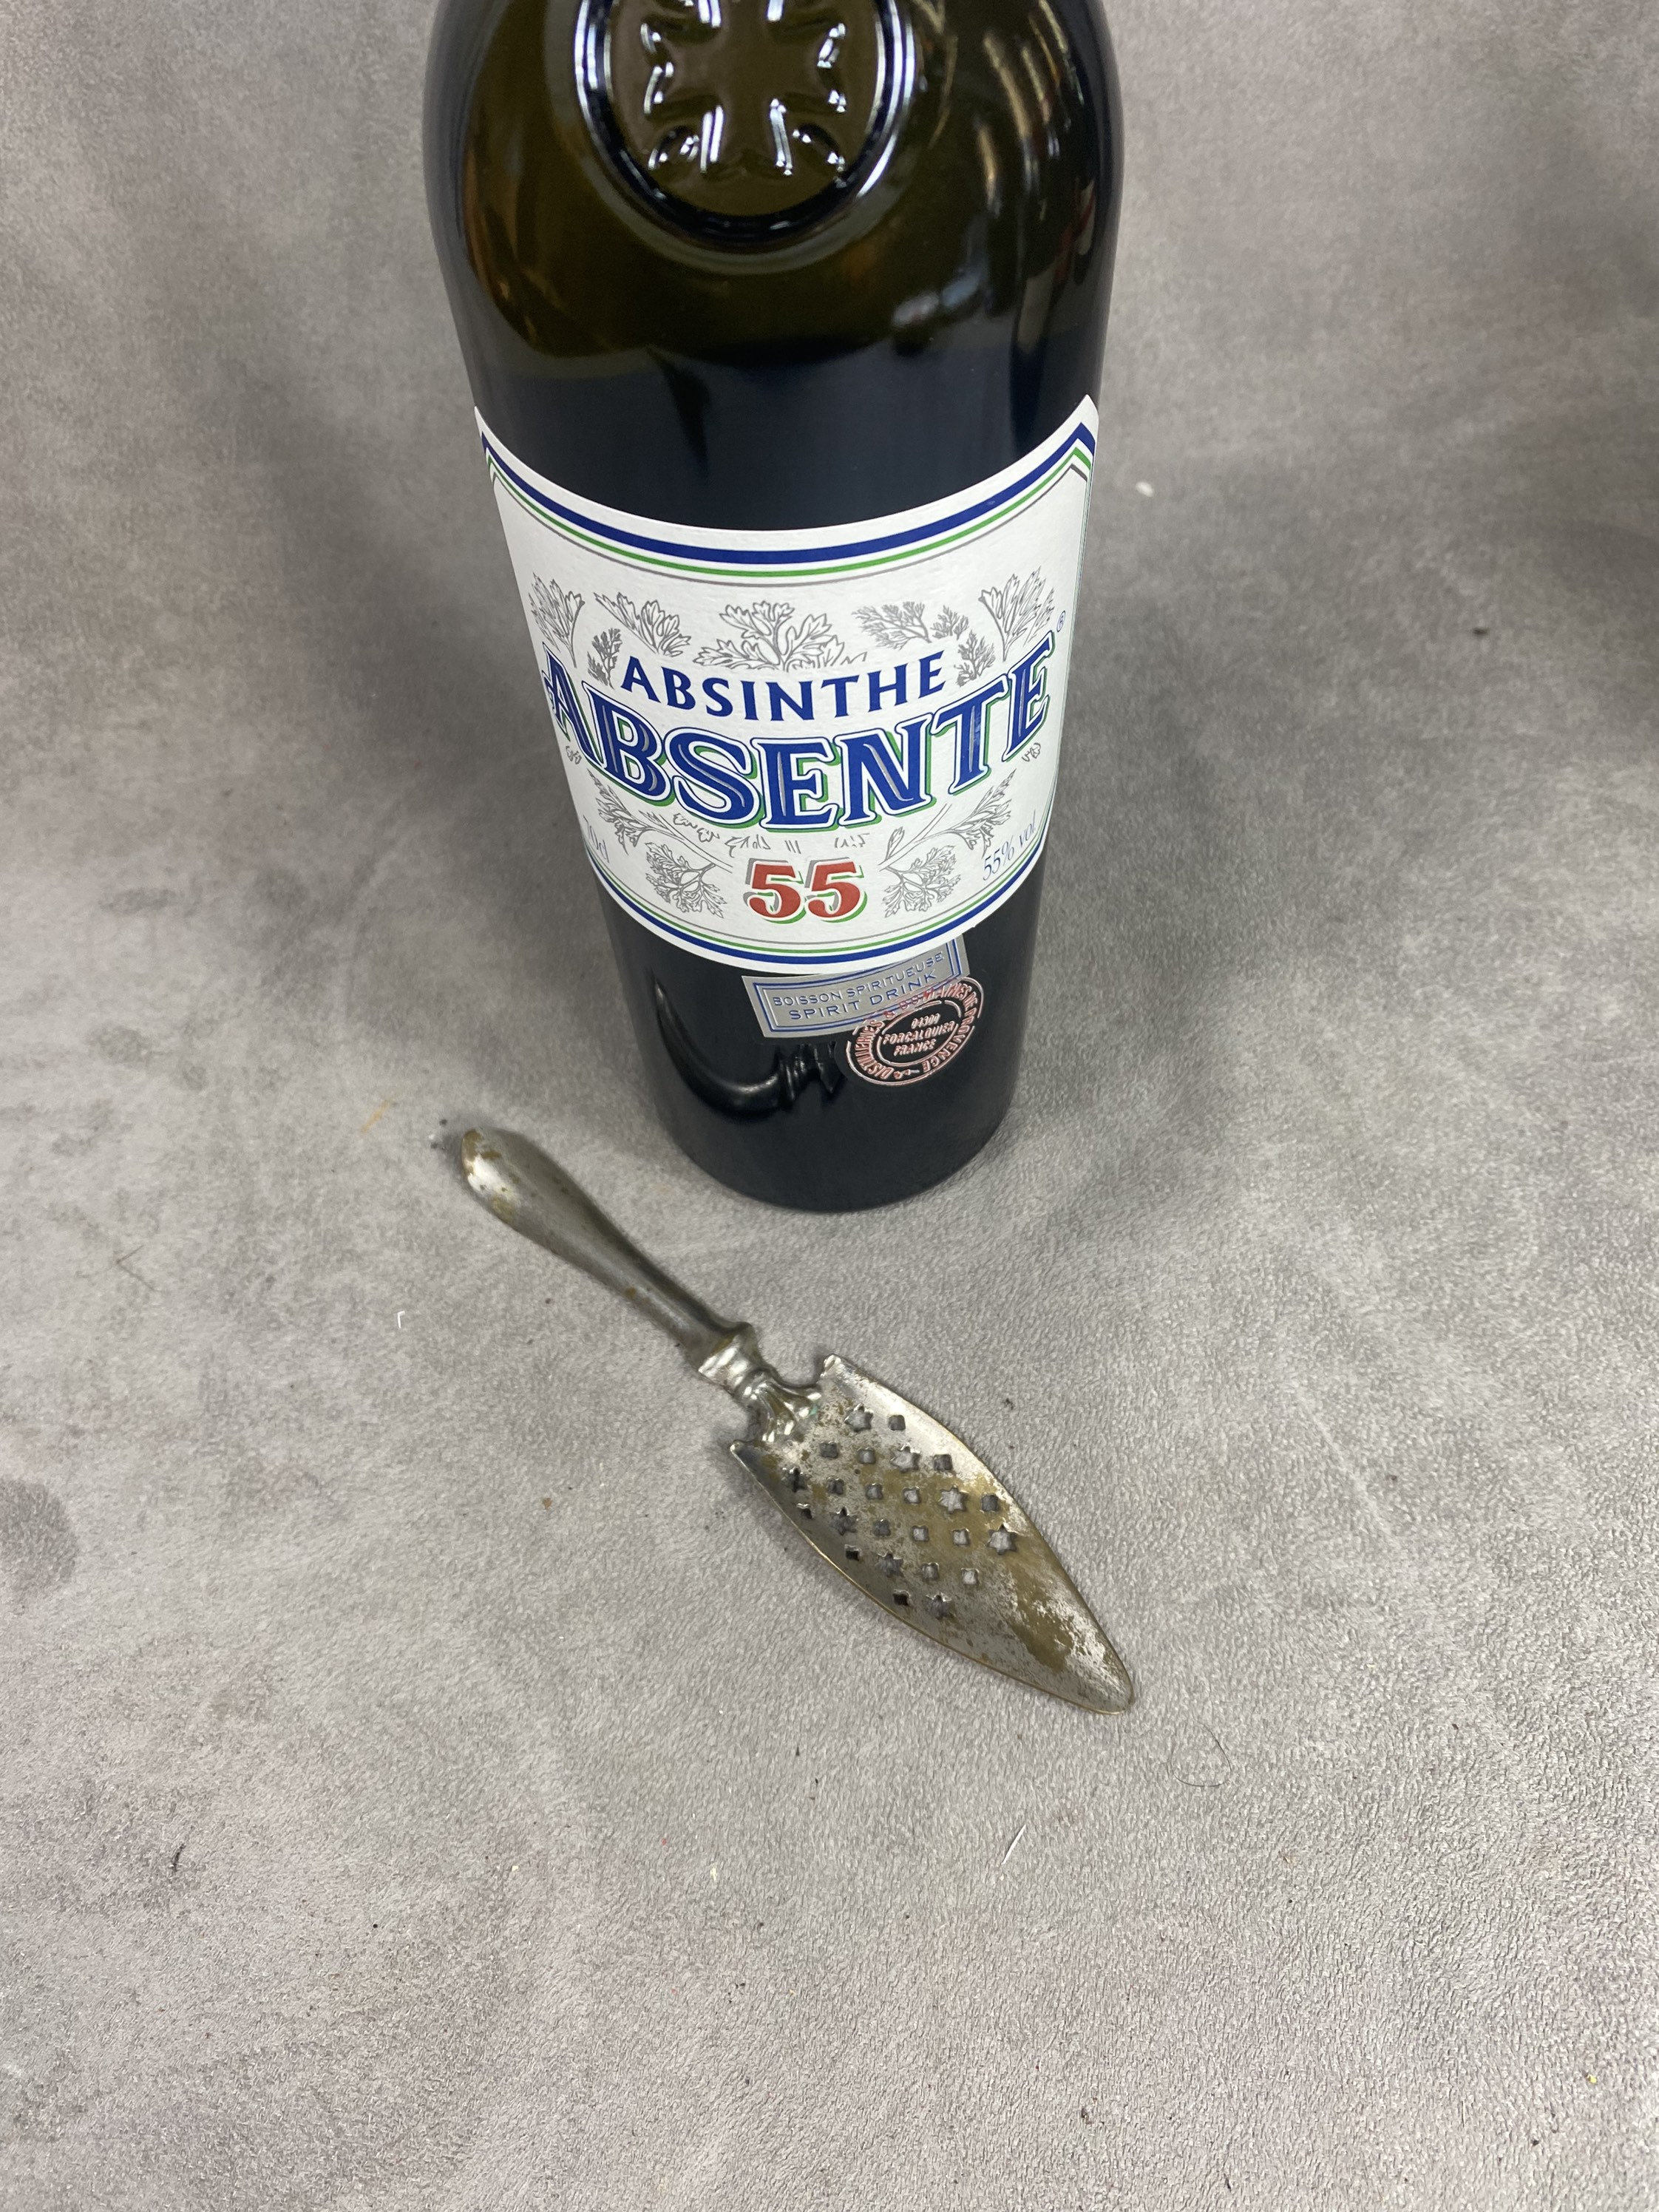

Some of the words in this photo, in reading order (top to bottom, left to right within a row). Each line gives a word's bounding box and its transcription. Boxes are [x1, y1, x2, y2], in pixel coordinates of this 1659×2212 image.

[621, 651, 945, 722] ABSINTHE
[541, 629, 1055, 831] ABSENTE
[983, 835, 1014, 881] 55%
[744, 858, 867, 923] 55
[773, 989, 844, 1007] BOISSON
[846, 951, 944, 998] SPIRITUEUSE
[789, 999, 863, 1020] SPIRIT
[869, 969, 937, 1006] DRINK
[893, 1038, 937, 1056] FRANCE
[922, 1007, 978, 1073] PROVENCE
